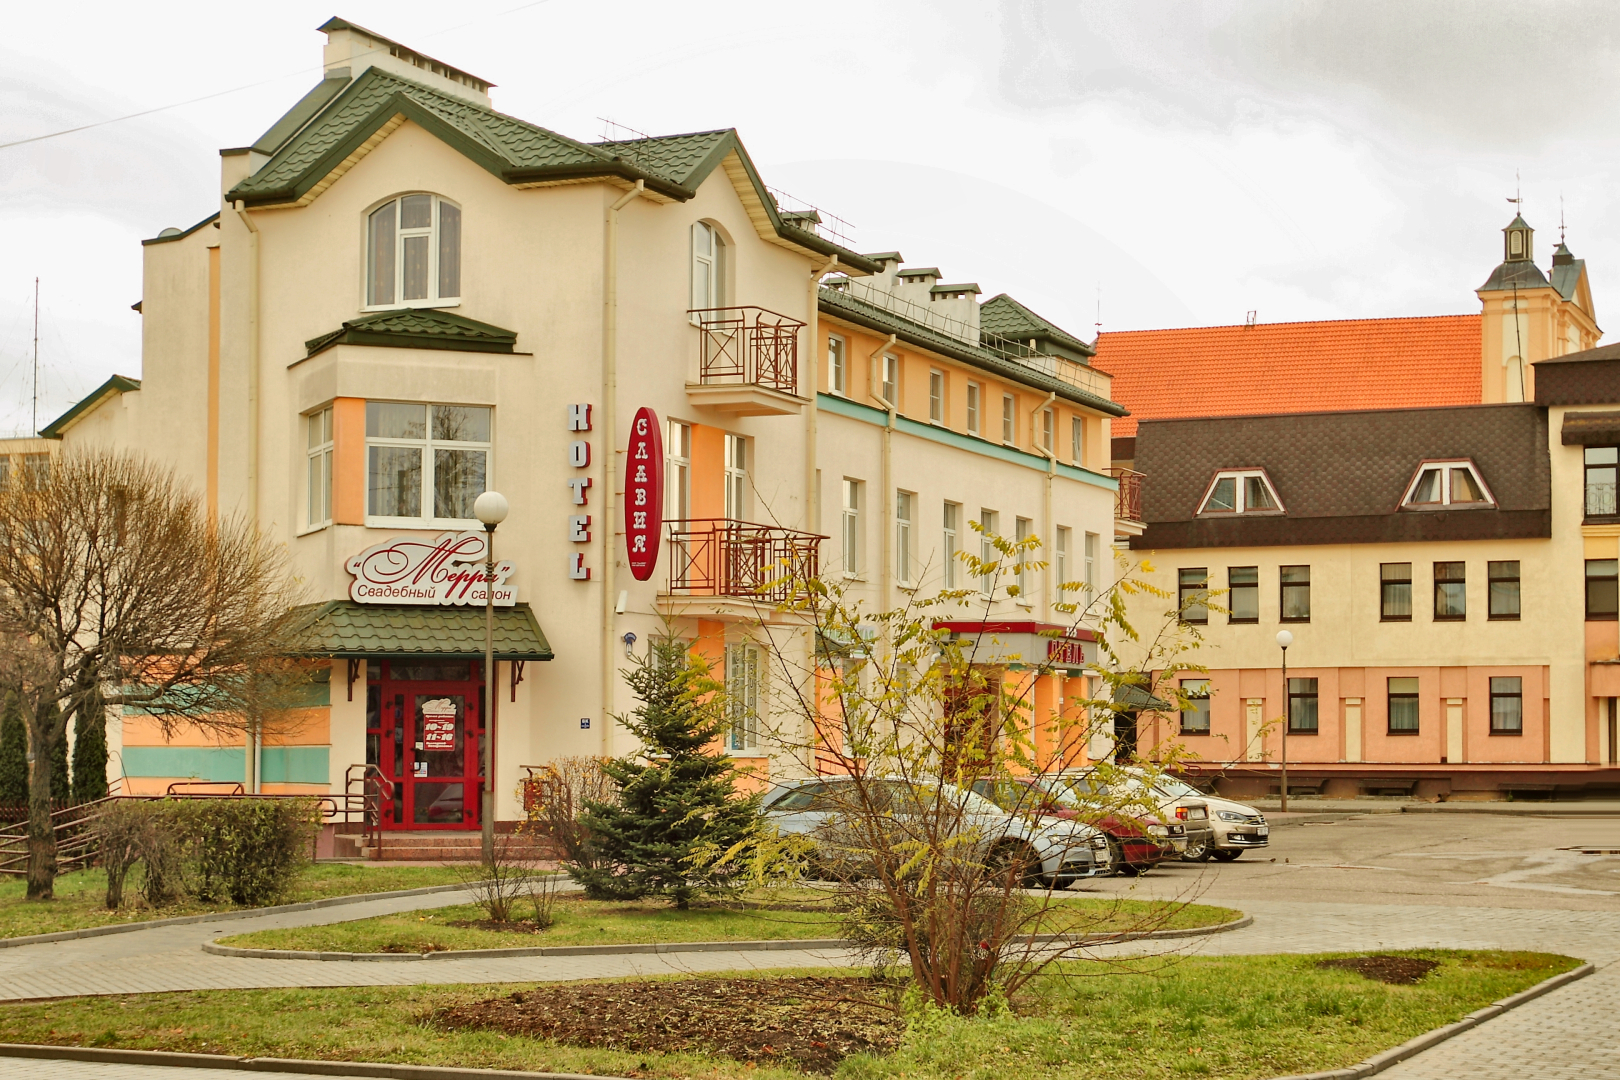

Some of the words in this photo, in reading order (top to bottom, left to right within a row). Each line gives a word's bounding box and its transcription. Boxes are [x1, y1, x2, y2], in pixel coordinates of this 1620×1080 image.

[567, 403, 592, 580] HOTEL
[632, 418, 648, 553] СЛАВИЯ
[357, 584, 436, 599] Свадебный
